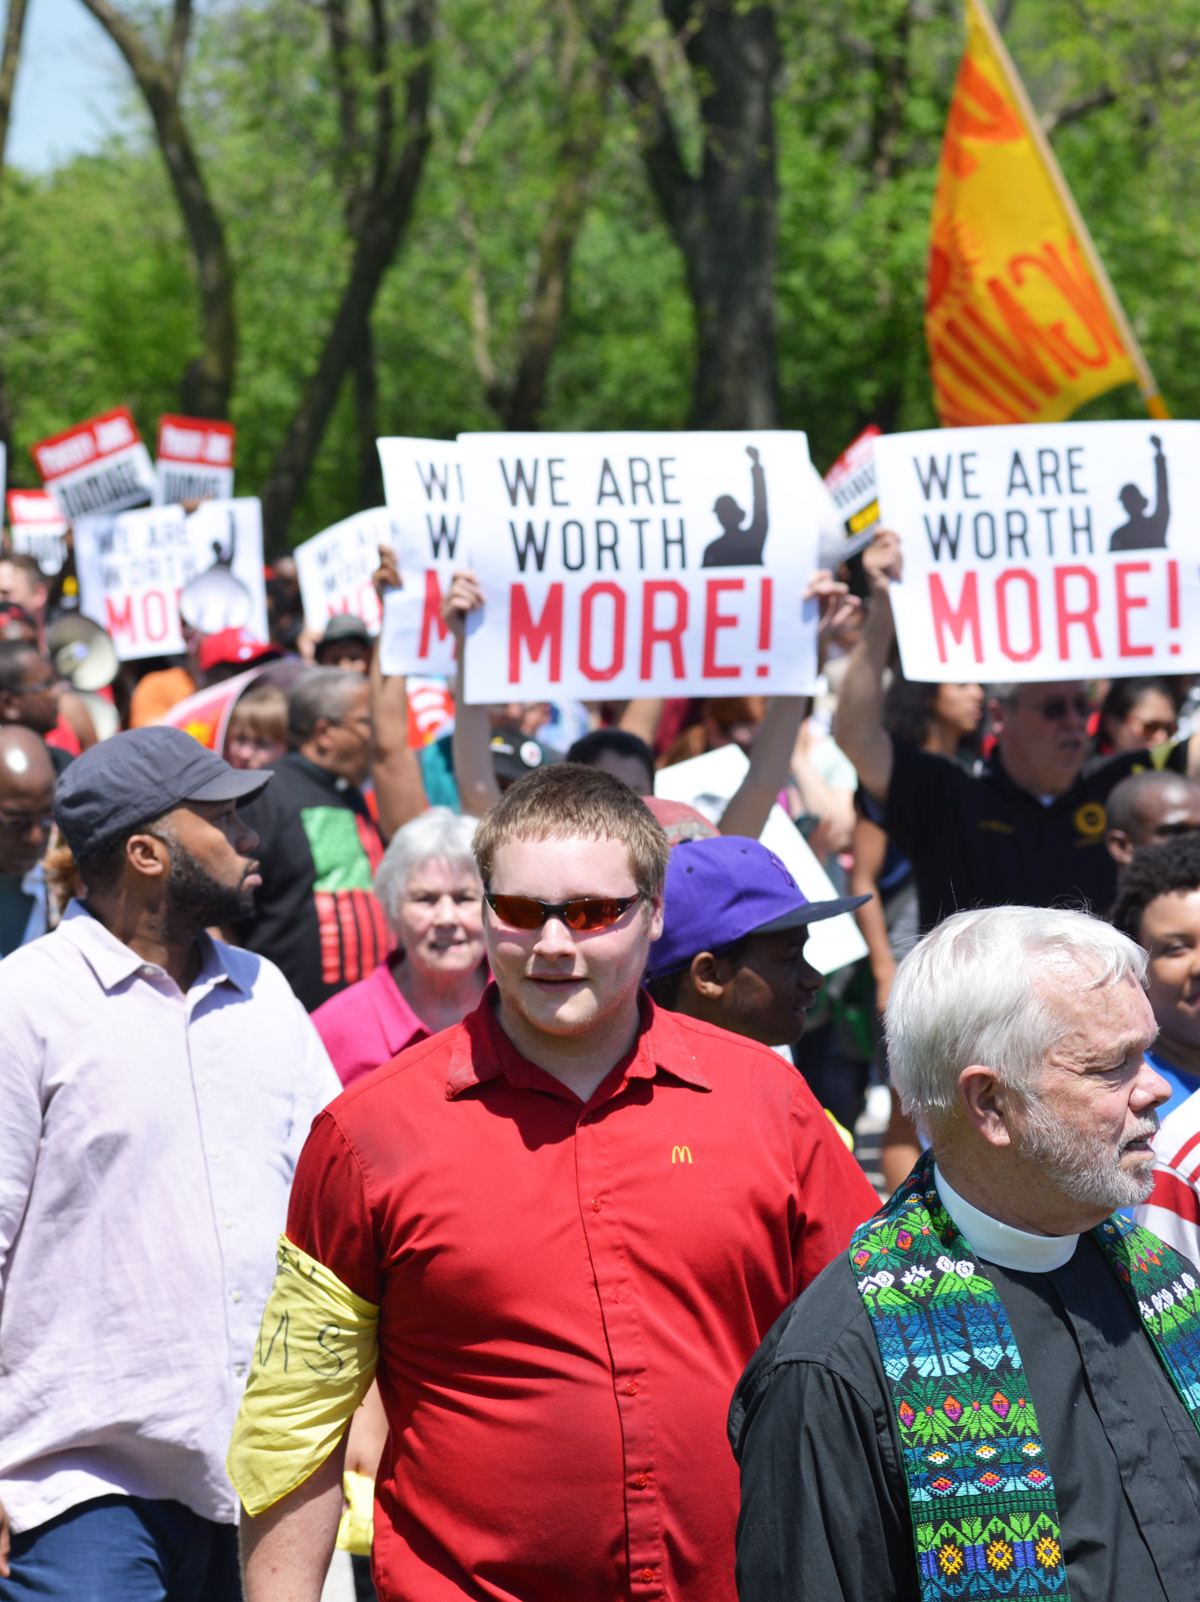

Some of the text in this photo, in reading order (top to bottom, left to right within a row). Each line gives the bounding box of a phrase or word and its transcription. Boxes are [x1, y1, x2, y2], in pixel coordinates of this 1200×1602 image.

[500, 456, 682, 508] WE ARE
[913, 452, 981, 502] WE
[1007, 446, 1088, 497] ARE
[509, 518, 687, 574] WORTH
[924, 506, 1094, 562] WORTH
[104, 588, 184, 647] MO
[507, 576, 774, 685] MORE!
[927, 559, 1182, 665] MORE!
